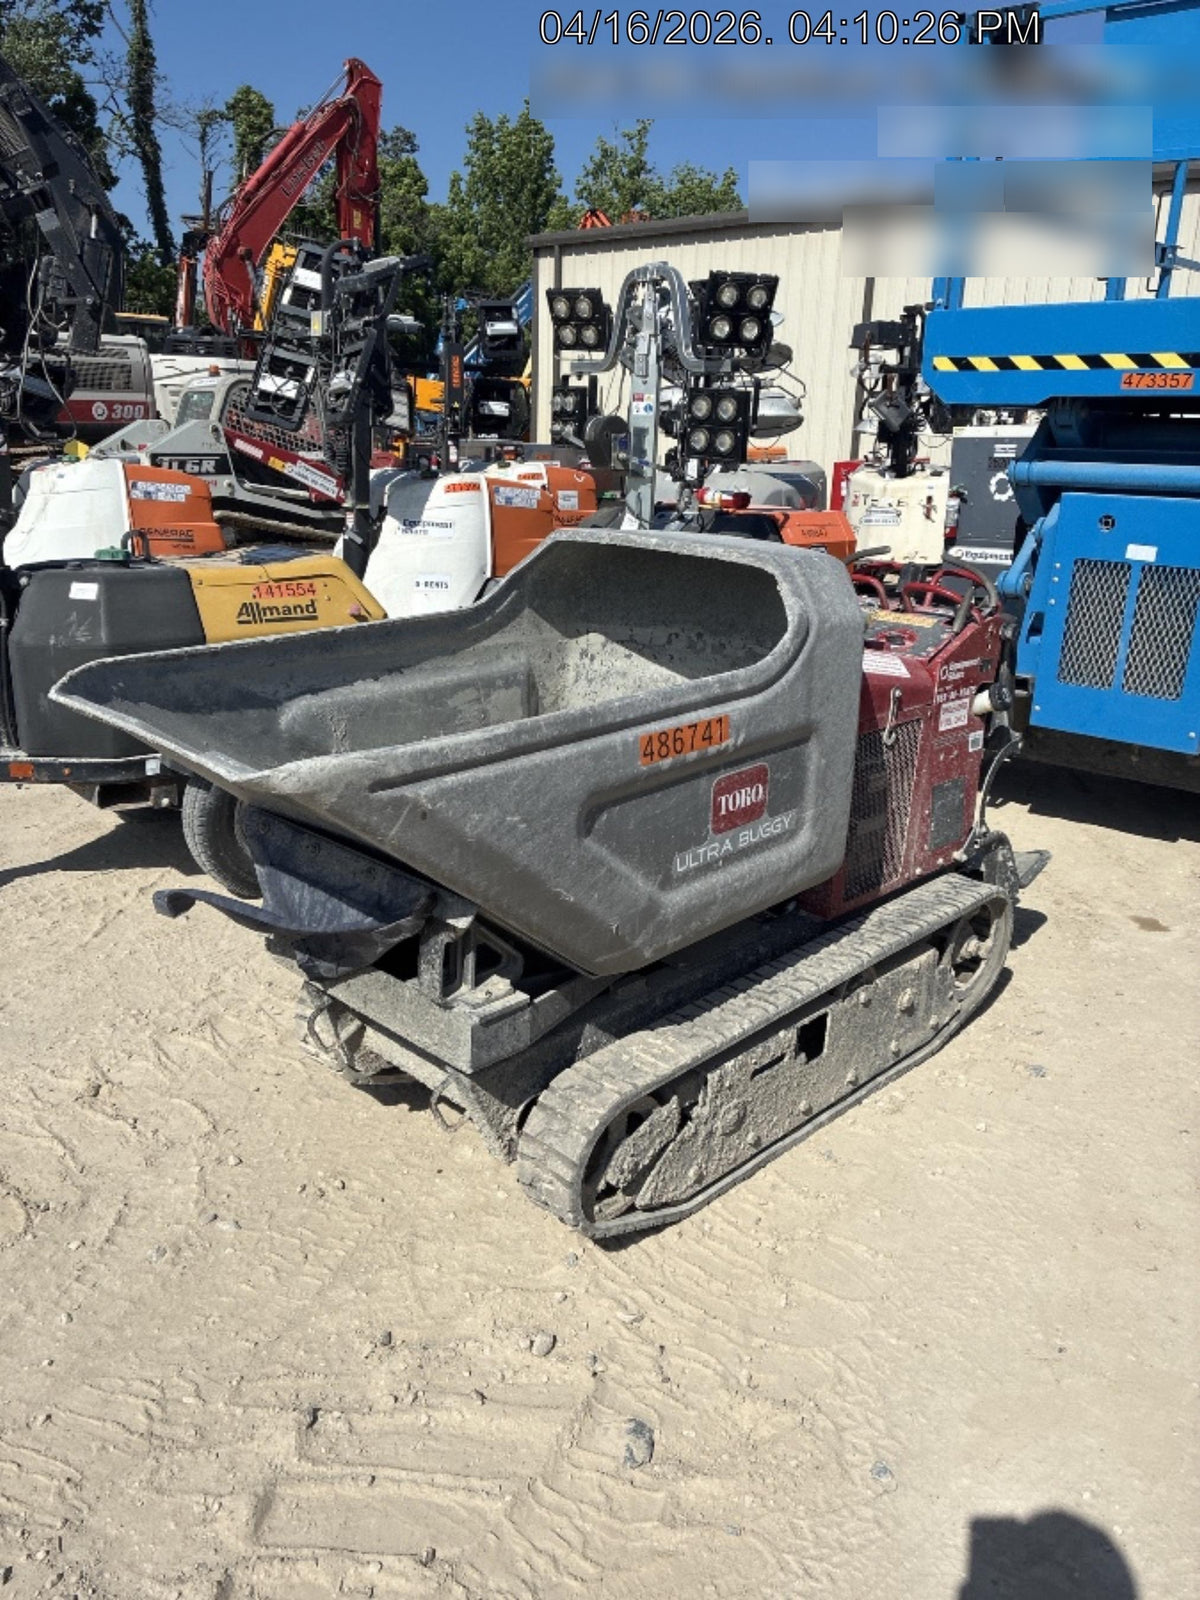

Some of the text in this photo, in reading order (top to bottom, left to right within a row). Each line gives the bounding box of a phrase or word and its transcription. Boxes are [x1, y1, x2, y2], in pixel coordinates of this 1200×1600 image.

[1122, 372, 1194, 389] 473357
[111, 404, 145, 419] 300
[253, 582, 317, 599] 141554
[236, 598, 318, 624] Allmand
[642, 715, 724, 763] 486741
[717, 782, 764, 817] TORO
[676, 812, 794, 872] ULTRA BUGGY
